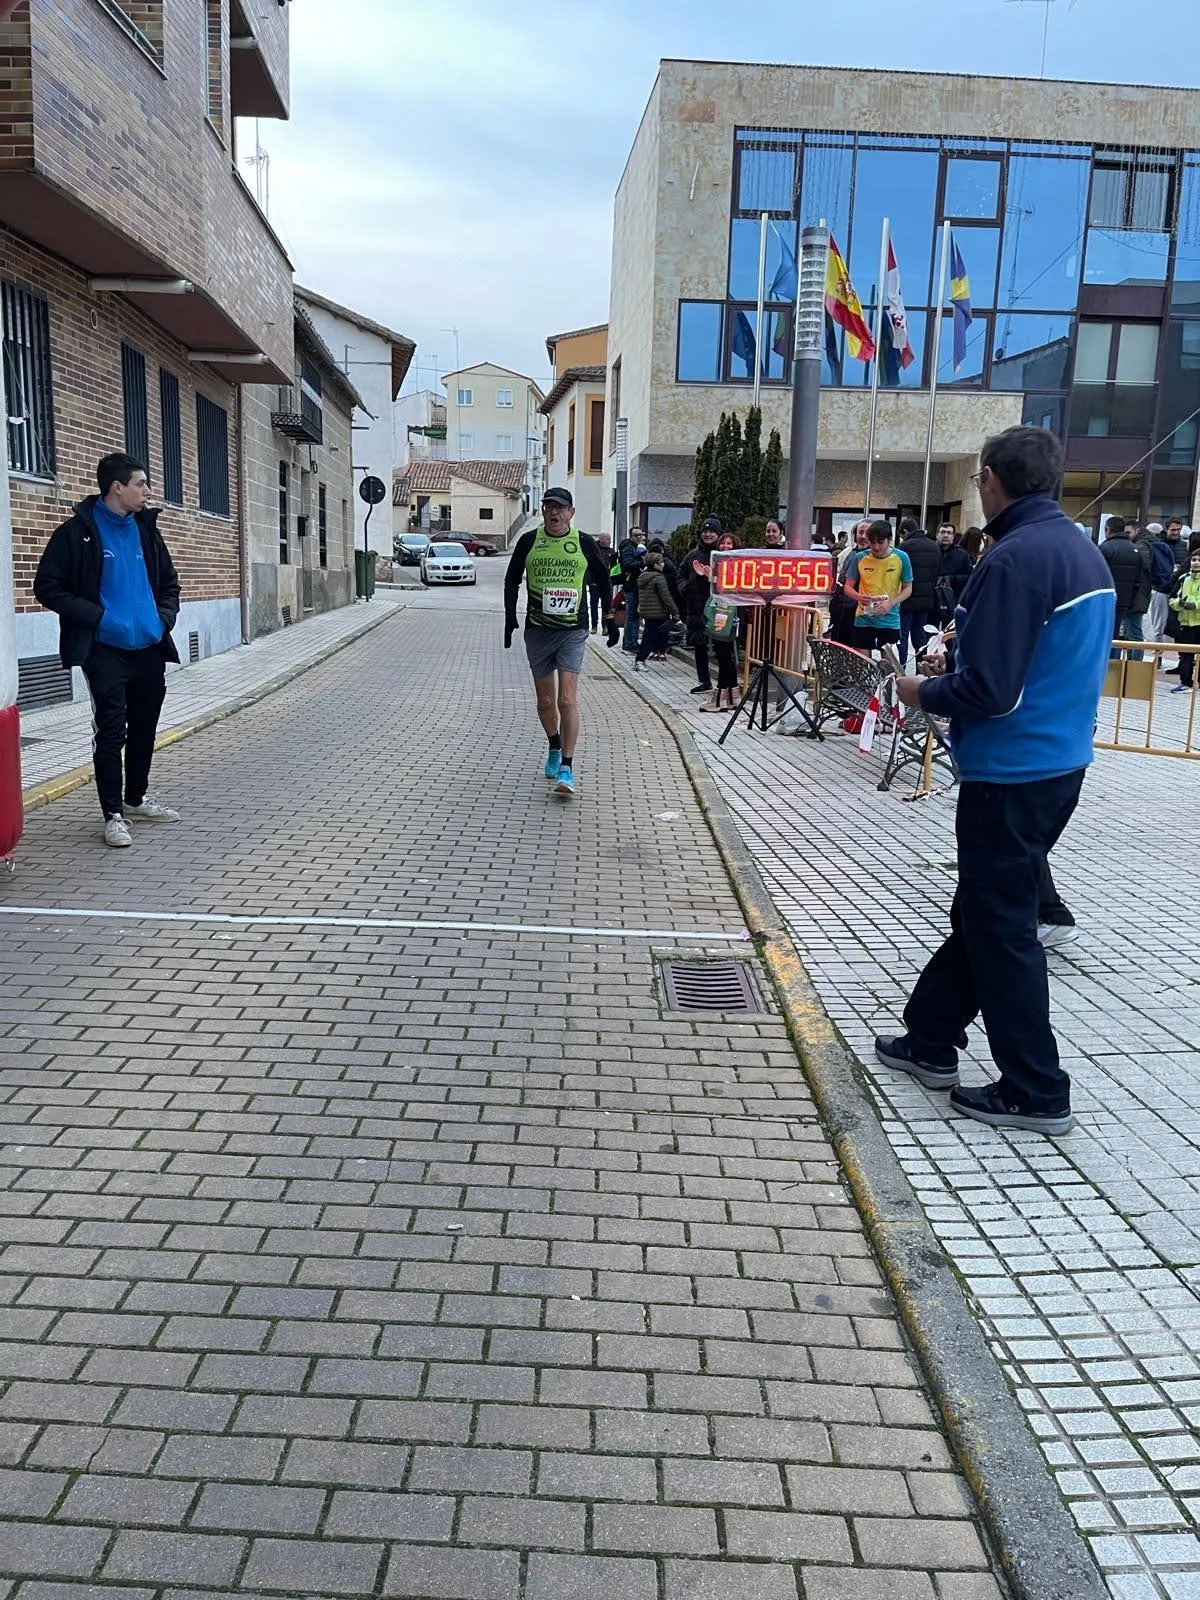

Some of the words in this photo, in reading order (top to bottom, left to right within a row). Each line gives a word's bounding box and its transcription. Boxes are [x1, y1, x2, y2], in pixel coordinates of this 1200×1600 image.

[532, 558, 578, 568] CORRECAMINOS
[534, 568, 575, 577] CARBAJOSA
[550, 597, 571, 608] 377
